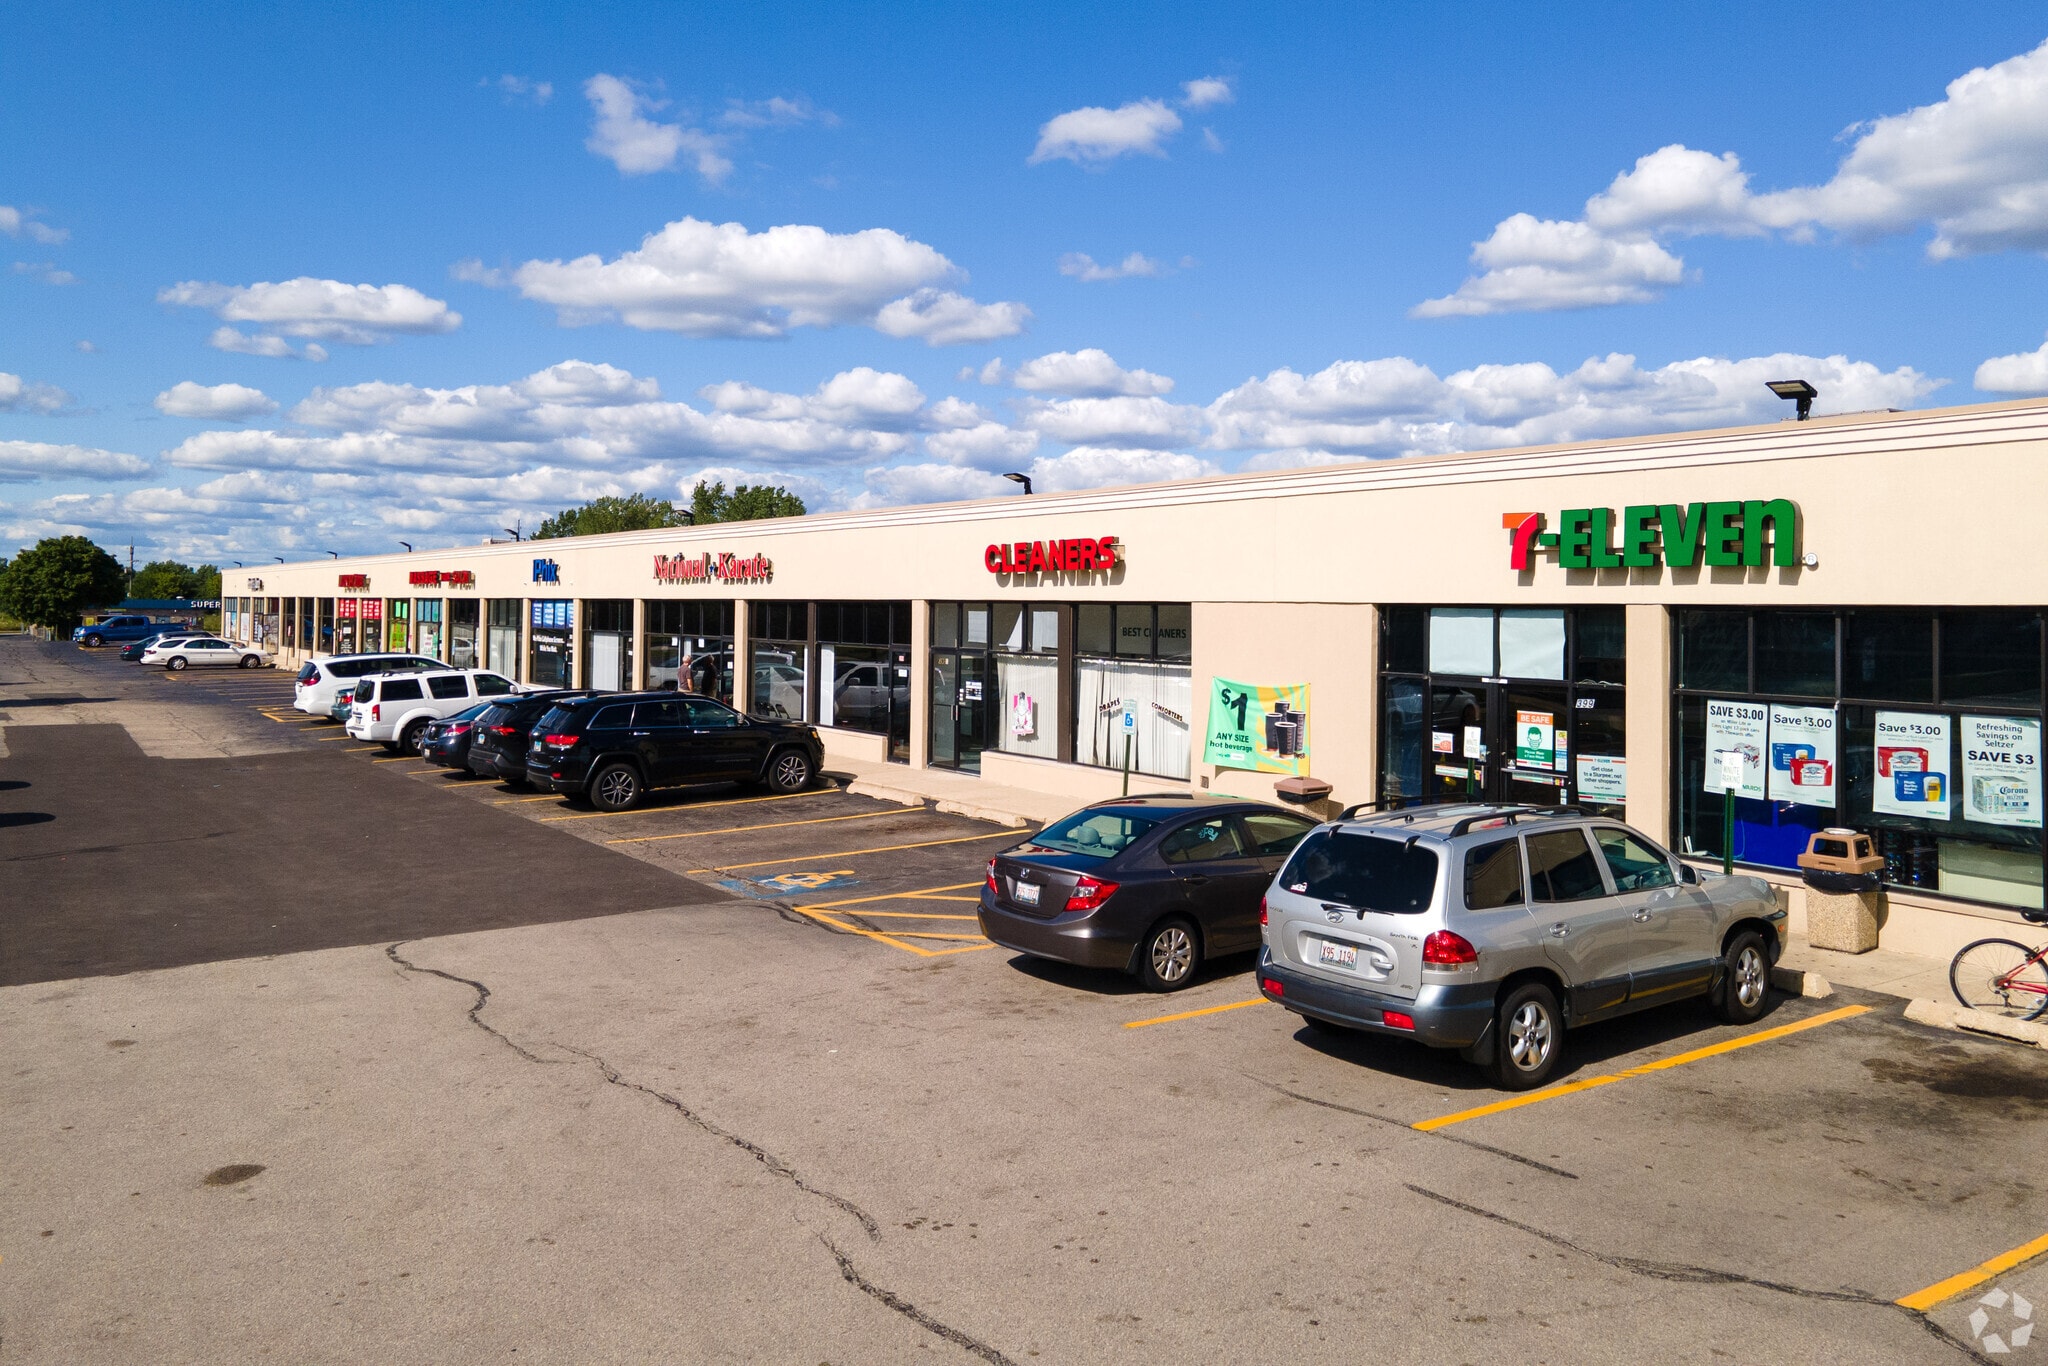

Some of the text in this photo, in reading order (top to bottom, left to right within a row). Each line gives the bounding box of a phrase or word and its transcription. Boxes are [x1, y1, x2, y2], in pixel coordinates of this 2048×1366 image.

[985, 536, 1117, 574] CLEANERS
[532, 558, 559, 582] Phix
[653, 552, 768, 580] National Karate
[190, 600, 221, 609] SUPER
[1122, 626, 1142, 637] BEST
[1099, 697, 1121, 712] DRAPES
[1221, 687, 1249, 731] $1
[1151, 702, 1184, 722] COMFORTERS
[1520, 714, 1550, 724] BE SAFE
[1710, 705, 1764, 721] SAVE $3.00
[1774, 713, 1832, 729] Save $3.00
[1879, 722, 1941, 736] Save $3.00
[1976, 723, 2023, 734] Refreshing
[1216, 732, 1250, 744] ANY SIZE
[1976, 731, 2009, 742] Savings
[1209, 740, 1253, 754] hot beverage
[1985, 740, 2015, 749] Seltzer
[1968, 750, 2035, 765] SAVE $3
[1999, 786, 2028, 795] Corona
[1322, 945, 1335, 960] X95
